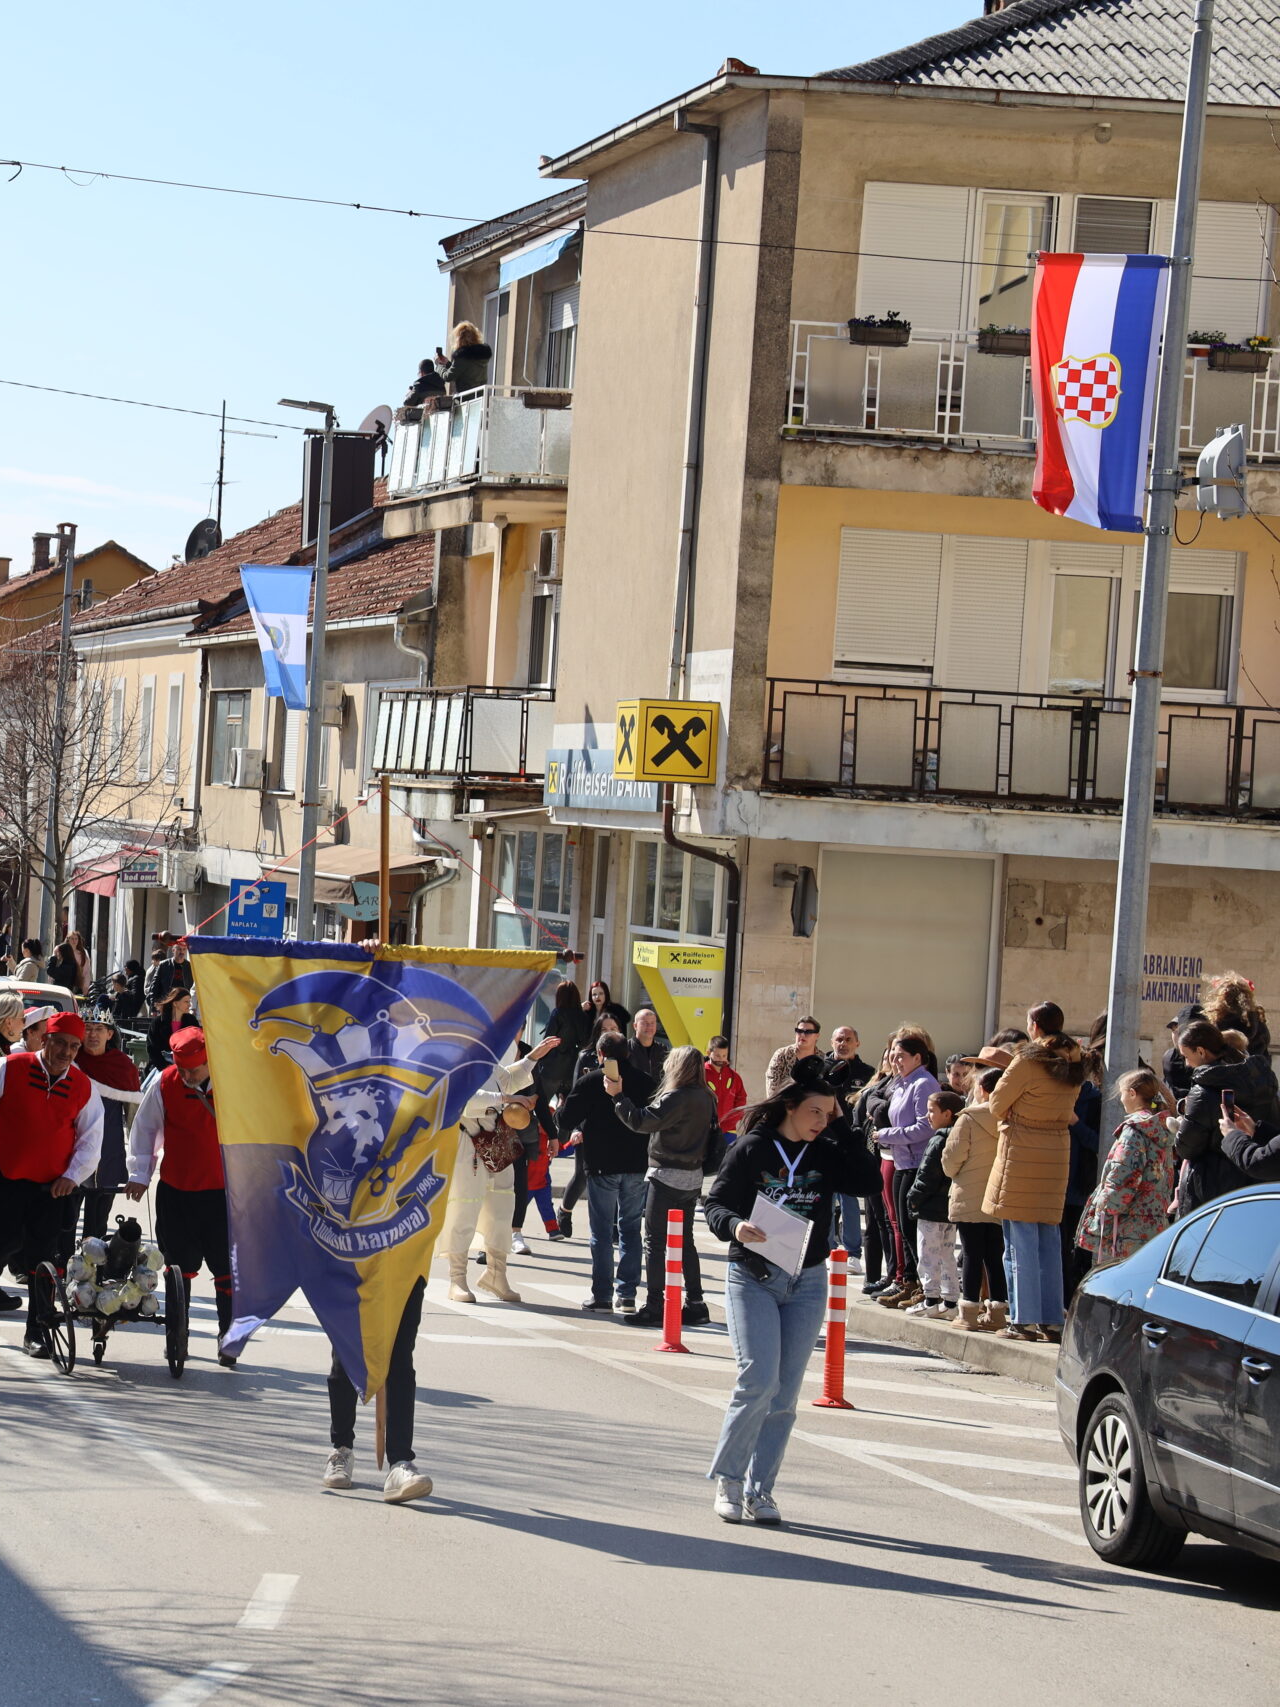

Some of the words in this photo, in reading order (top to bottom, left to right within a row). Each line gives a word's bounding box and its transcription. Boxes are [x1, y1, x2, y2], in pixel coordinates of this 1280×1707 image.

[558, 759, 614, 797] Raiffeisen
[237, 885, 261, 916] P
[1143, 954, 1203, 978] ABRANJENO
[672, 976, 713, 984] BANKOMAT
[1141, 981, 1201, 1004] LAKATIRANJE
